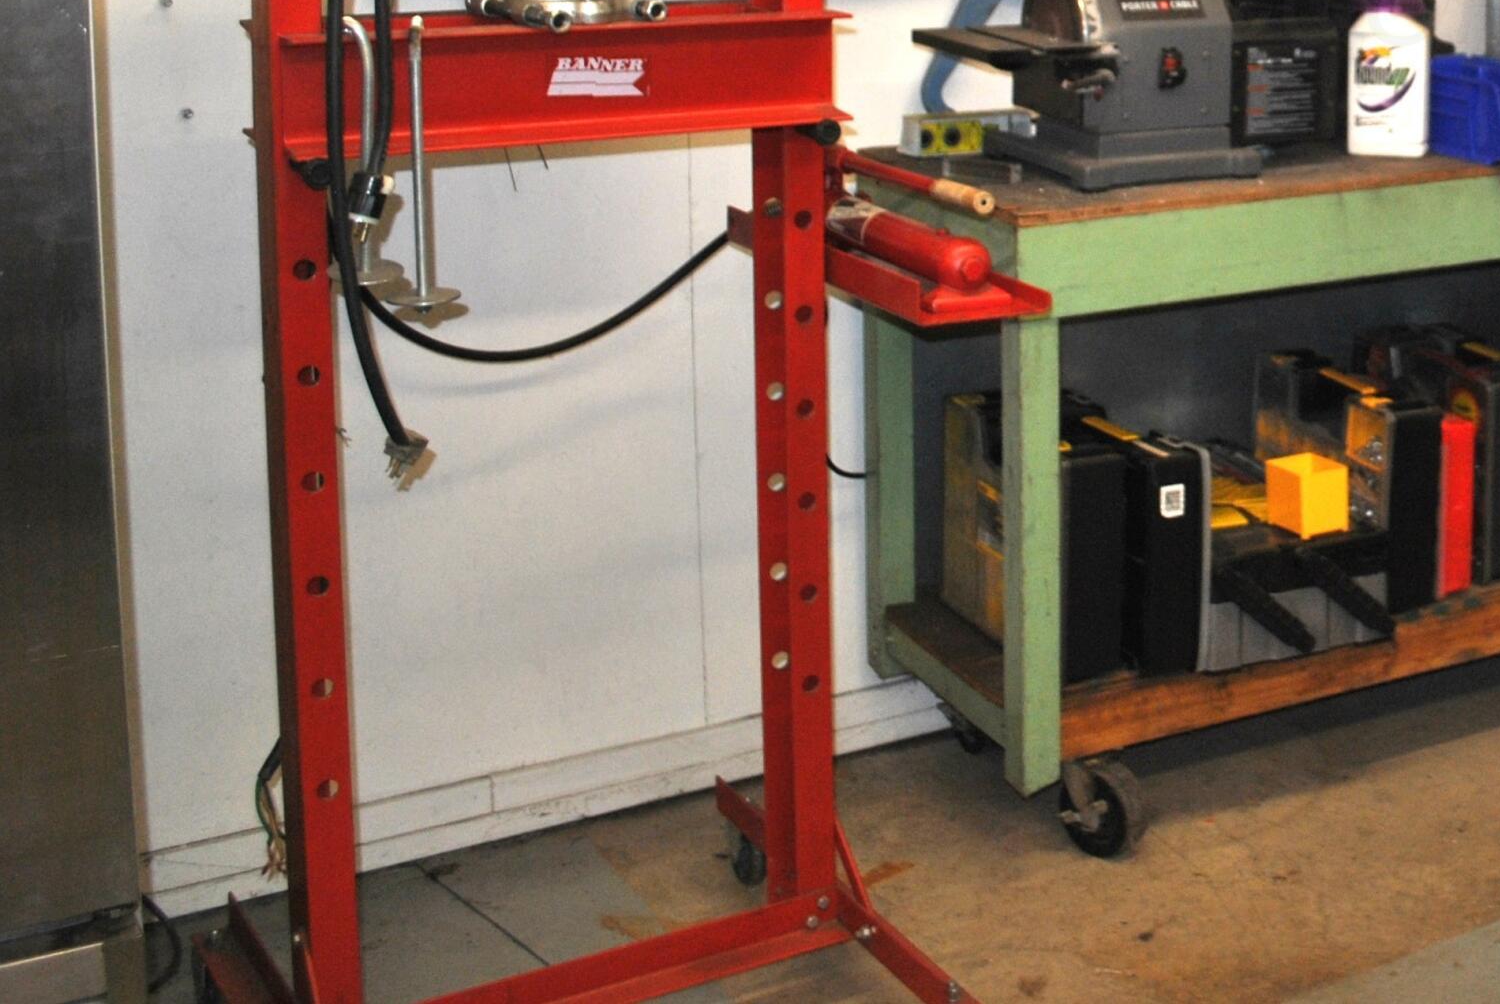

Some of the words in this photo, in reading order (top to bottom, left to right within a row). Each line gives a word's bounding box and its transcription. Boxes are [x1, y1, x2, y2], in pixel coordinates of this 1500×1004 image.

[1120, 0, 1158, 12] PORTER
[1169, 0, 1200, 10] CABLE
[556, 56, 644, 72] BANNER
